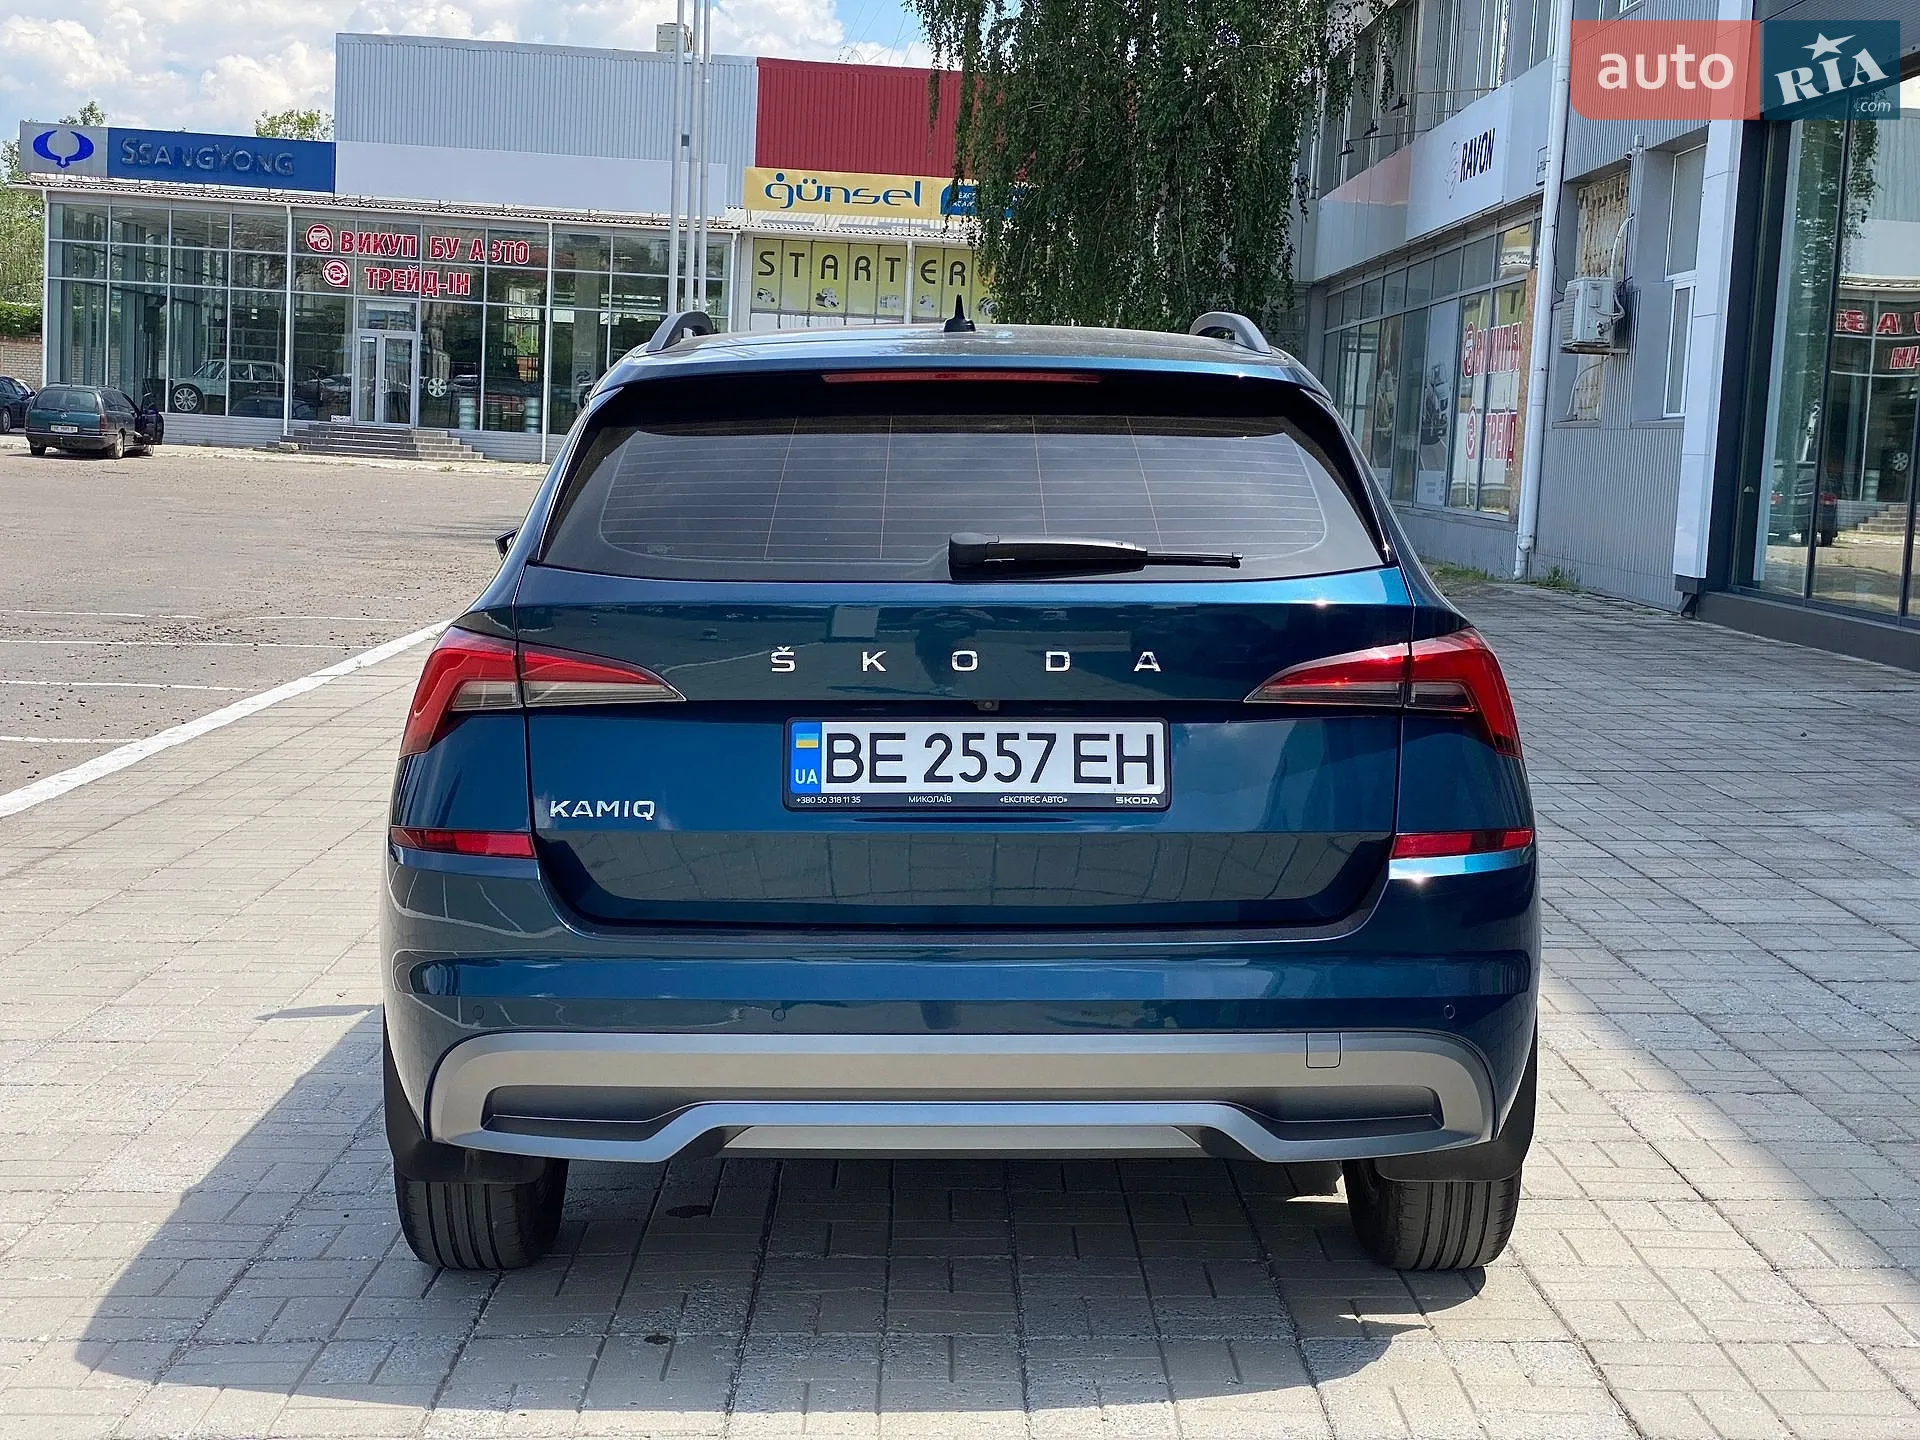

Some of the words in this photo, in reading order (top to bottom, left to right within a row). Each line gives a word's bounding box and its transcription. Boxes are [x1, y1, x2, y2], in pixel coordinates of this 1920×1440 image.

[1460, 127, 1496, 183] RAVON
[764, 172, 922, 209] günsel
[340, 231, 418, 258] ВИКУП
[429, 236, 461, 261] БУ
[469, 239, 530, 265] АВТО
[364, 265, 472, 297] ТРЕЙД-ІН
[758, 250, 967, 287] STARTER
[770, 645, 1162, 672] ŠKODA
[826, 732, 907, 784] BE
[923, 732, 1057, 784] 2557
[1073, 733, 1155, 785] EH
[795, 768, 819, 785] UA
[549, 800, 655, 821] KAMIQ
[796, 795, 816, 804] +380
[817, 795, 828, 804] 50
[829, 795, 842, 804] 318
[842, 795, 850, 804] 11
[908, 794, 952, 804] МИКОЛАЇВ
[1115, 796, 1159, 805] SKODA
